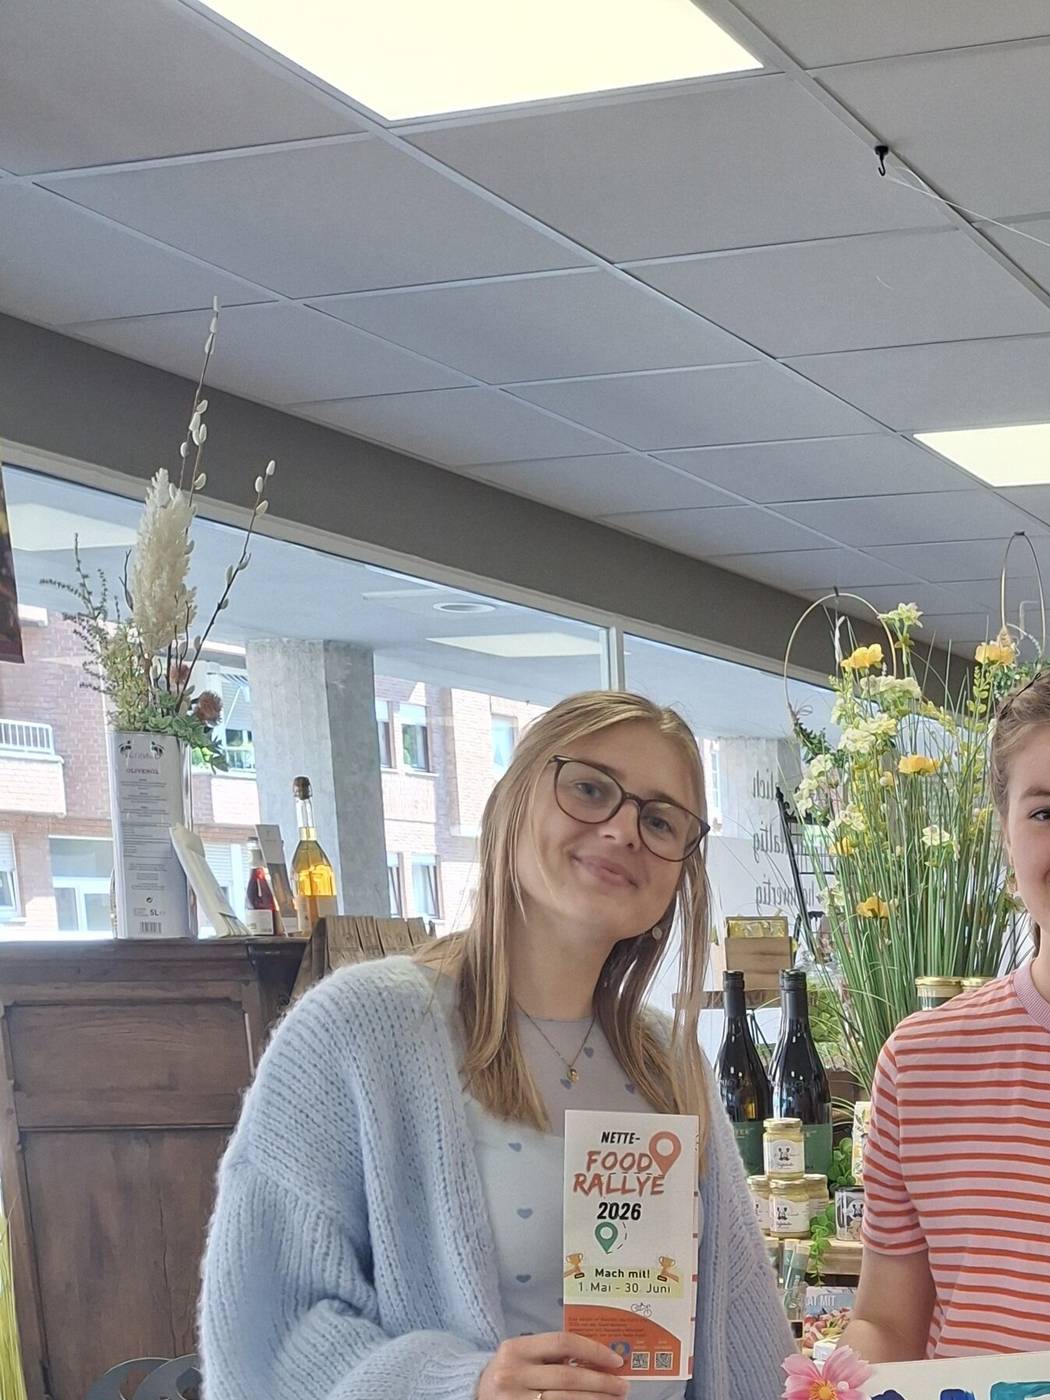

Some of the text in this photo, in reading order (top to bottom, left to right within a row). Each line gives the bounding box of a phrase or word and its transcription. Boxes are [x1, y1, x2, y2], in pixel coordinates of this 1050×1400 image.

[601, 1131, 641, 1145] NETTE-
[586, 1150, 653, 1173] FOOD
[573, 1173, 666, 1198] RALLYE
[597, 1202, 642, 1221] 2026
[595, 1267, 651, 1279] Mach mit!
[591, 1282, 611, 1293] Mai
[645, 1282, 671, 1295] Juni
